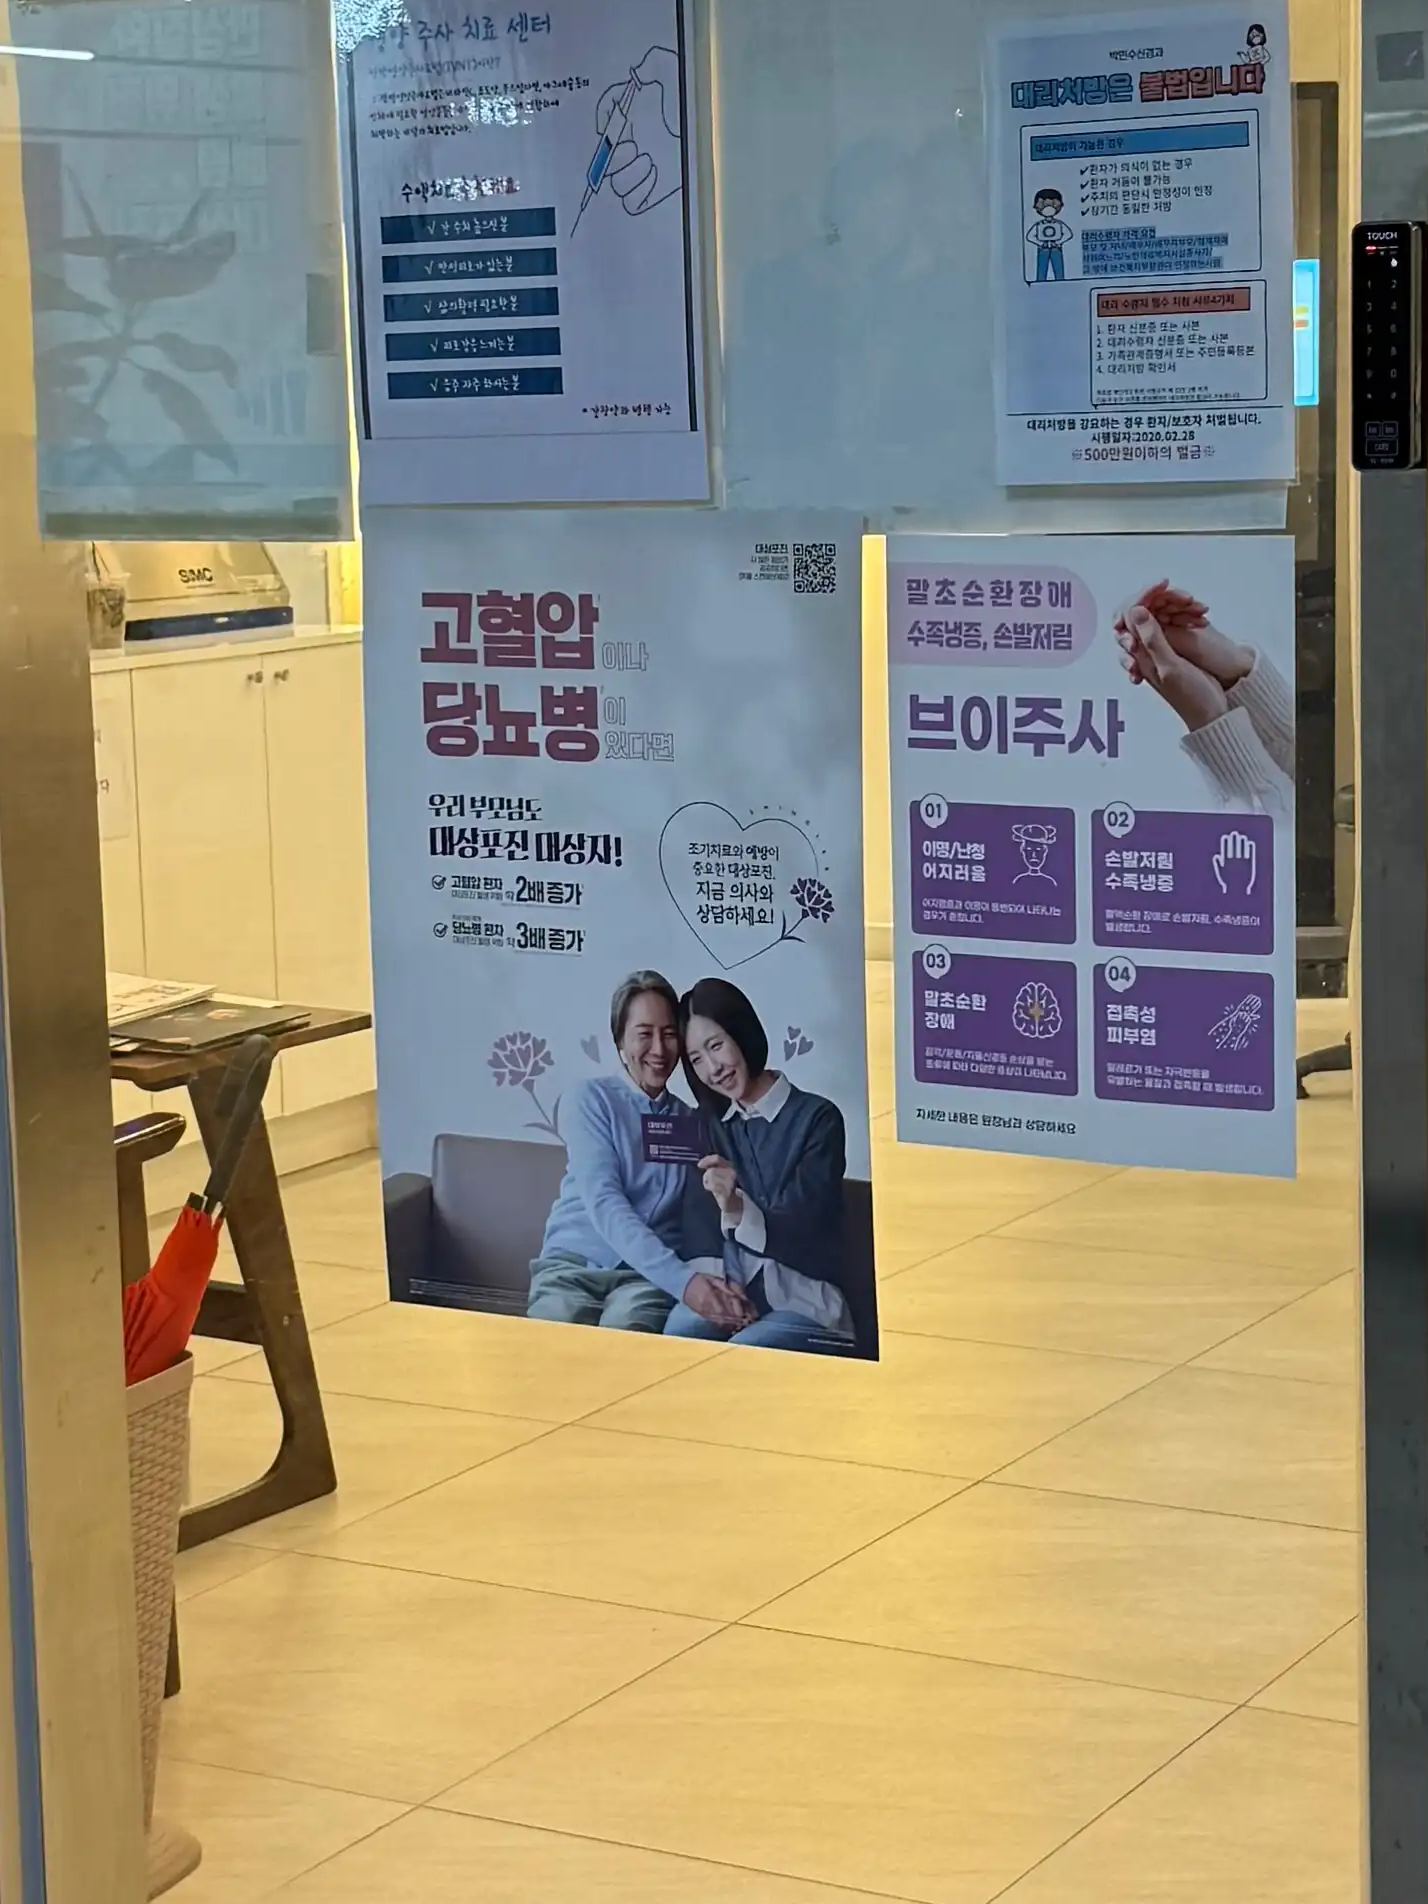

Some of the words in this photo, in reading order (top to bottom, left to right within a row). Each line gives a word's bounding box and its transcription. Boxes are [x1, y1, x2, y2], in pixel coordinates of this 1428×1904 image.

[418, 20, 454, 52] 주사
[463, 13, 499, 41] 치료
[507, 12, 551, 43] 센터
[1011, 73, 1134, 109] 대리처방은
[1139, 63, 1266, 103] 불법입니다
[420, 590, 600, 670] 고혈압
[907, 620, 988, 651] 수족냉증,
[994, 622, 1072, 651] 손발저림
[421, 681, 601, 763] 당뇨병
[907, 694, 1125, 758] 브이주사
[605, 732, 675, 762] 있다면
[428, 793, 465, 817] 우리
[469, 796, 543, 821] 부모님도
[924, 802, 942, 819] 01
[1107, 811, 1129, 828] 02
[429, 826, 529, 861] 대상포진
[534, 831, 623, 867] 대상자!
[688, 843, 743, 859] 조기치료와
[922, 840, 986, 861] 이명/난청
[693, 862, 725, 877] 중요한
[1104, 851, 1174, 870] 손발저림
[922, 863, 986, 883] 어지러움
[1104, 872, 1174, 892] 수족냉증
[516, 875, 545, 903] 2배
[547, 882, 582, 906] 증가
[696, 881, 725, 901] 지금
[730, 882, 774, 904] 의사와
[697, 904, 774, 925] 상담하세요!
[516, 922, 546, 950] 3배
[549, 928, 584, 952] 증가
[926, 953, 946, 969] 03
[1108, 965, 1131, 983] 04
[924, 990, 987, 1011] 말초순환
[924, 1011, 955, 1031] 장애
[1106, 1026, 1157, 1046] 피부염
